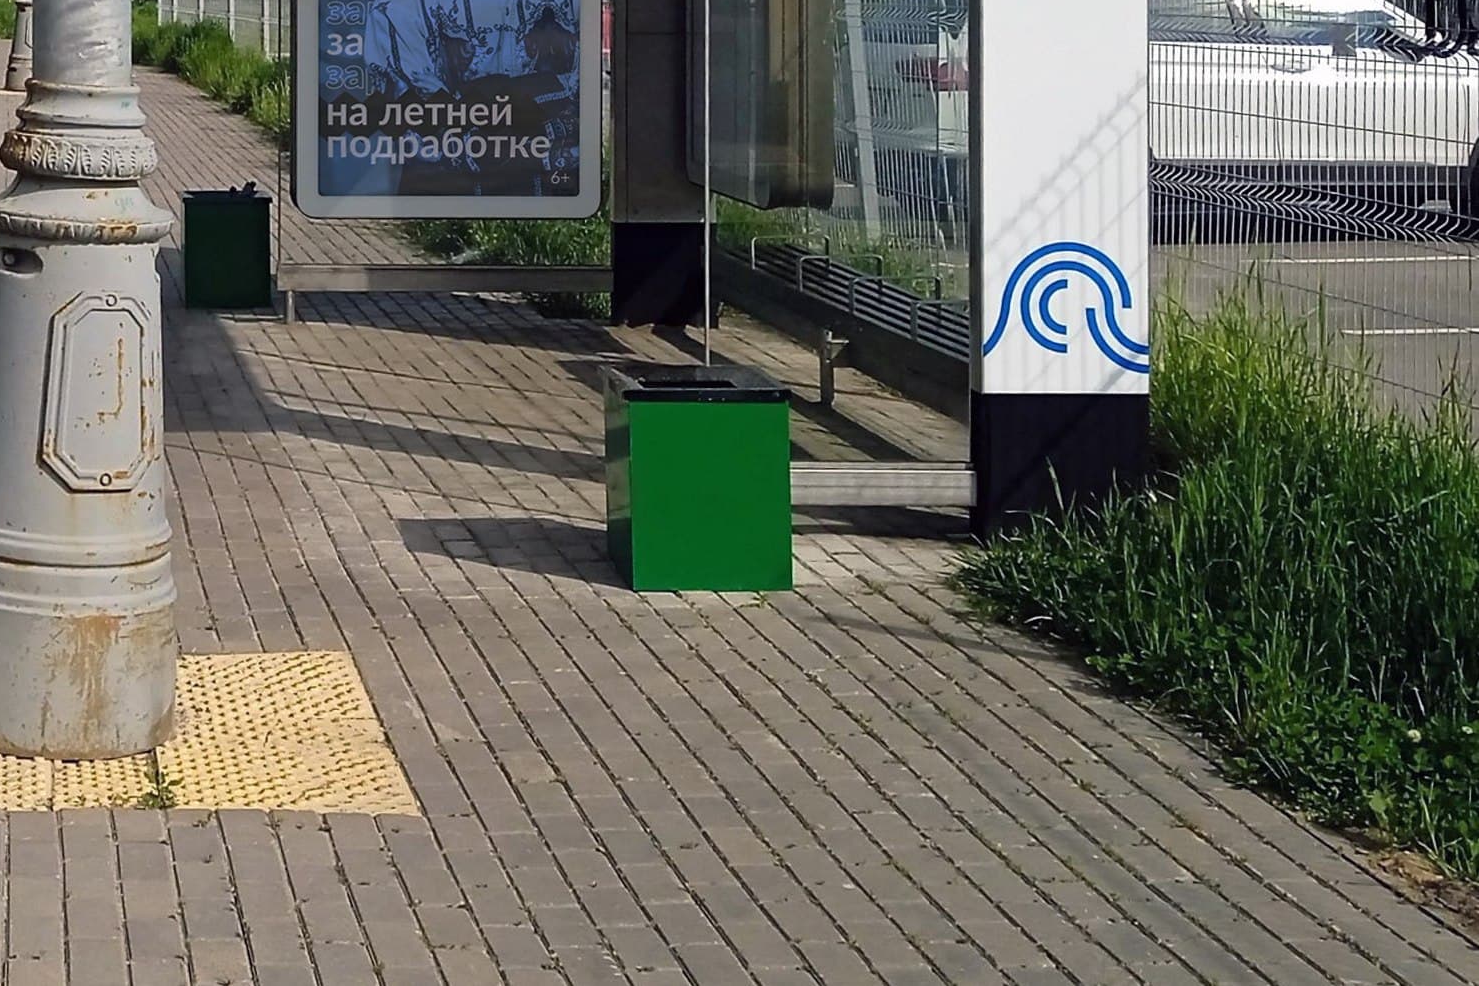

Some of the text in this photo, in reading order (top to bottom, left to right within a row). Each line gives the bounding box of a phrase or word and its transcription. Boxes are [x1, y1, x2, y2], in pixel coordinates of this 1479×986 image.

[327, 95, 512, 126] на летней
[327, 128, 552, 165] подработке
[550, 171, 570, 184] 6+
